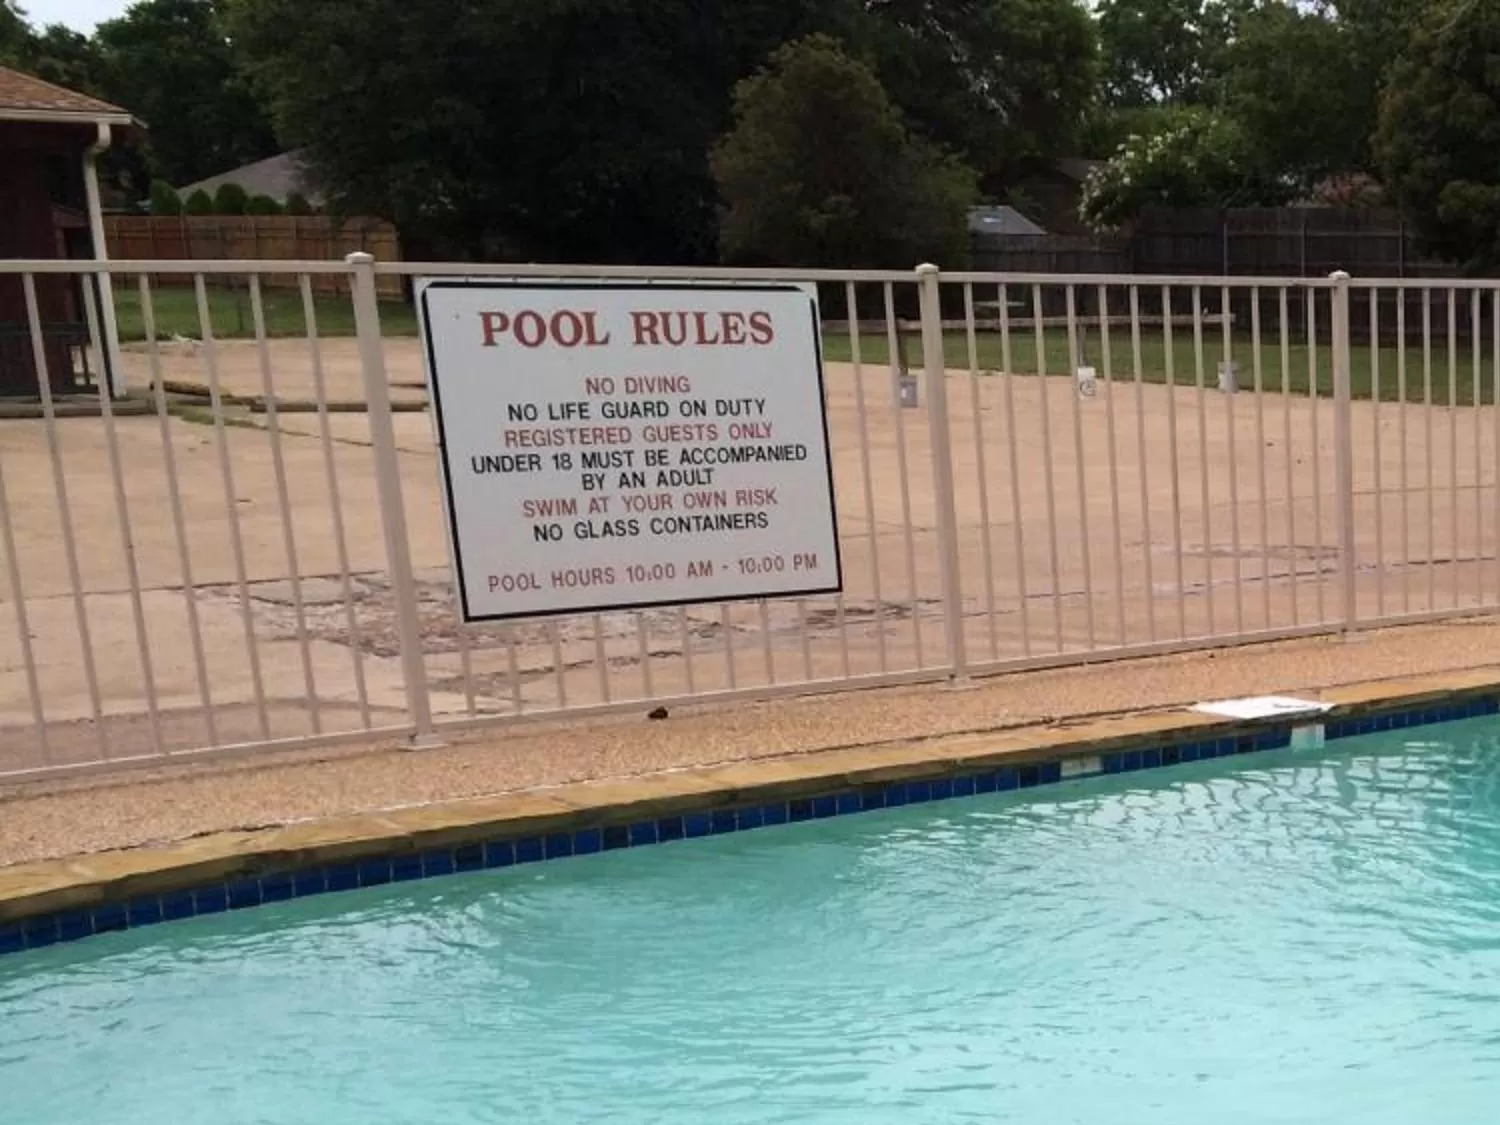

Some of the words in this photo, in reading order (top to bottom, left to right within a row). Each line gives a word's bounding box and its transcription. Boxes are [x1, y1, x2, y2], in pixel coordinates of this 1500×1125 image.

[478, 310, 609, 347] POOL
[629, 311, 774, 346] RULES
[585, 377, 615, 395] NO
[625, 376, 690, 394] DIVING
[508, 404, 538, 421] NO
[548, 403, 590, 420] LIFE
[601, 400, 669, 419] GUARD
[679, 400, 707, 417] ON
[715, 399, 766, 416] DUTY
[504, 426, 631, 448] REGISTERED
[643, 425, 718, 443] GUESTS
[729, 423, 773, 439] ONLY
[472, 454, 541, 474] UNDER
[553, 453, 572, 470] 18
[581, 451, 634, 469] MUST
[645, 450, 669, 466] BE
[680, 445, 806, 465] ACCOMPANIED
[582, 473, 605, 491] BY
[618, 472, 646, 489] AN
[656, 469, 714, 487] ADULT
[523, 500, 578, 518] SWIM
[588, 498, 611, 514] AT
[621, 494, 673, 512] YOUR
[683, 492, 727, 510] OWN
[735, 489, 778, 507] RISK
[533, 523, 563, 541] NO
[574, 519, 640, 539] GLASS
[650, 512, 769, 535] CONTAINERS
[488, 572, 540, 592] POOL
[551, 568, 615, 588] HOURS
[686, 561, 713, 578] AM
[793, 553, 818, 571] PM
